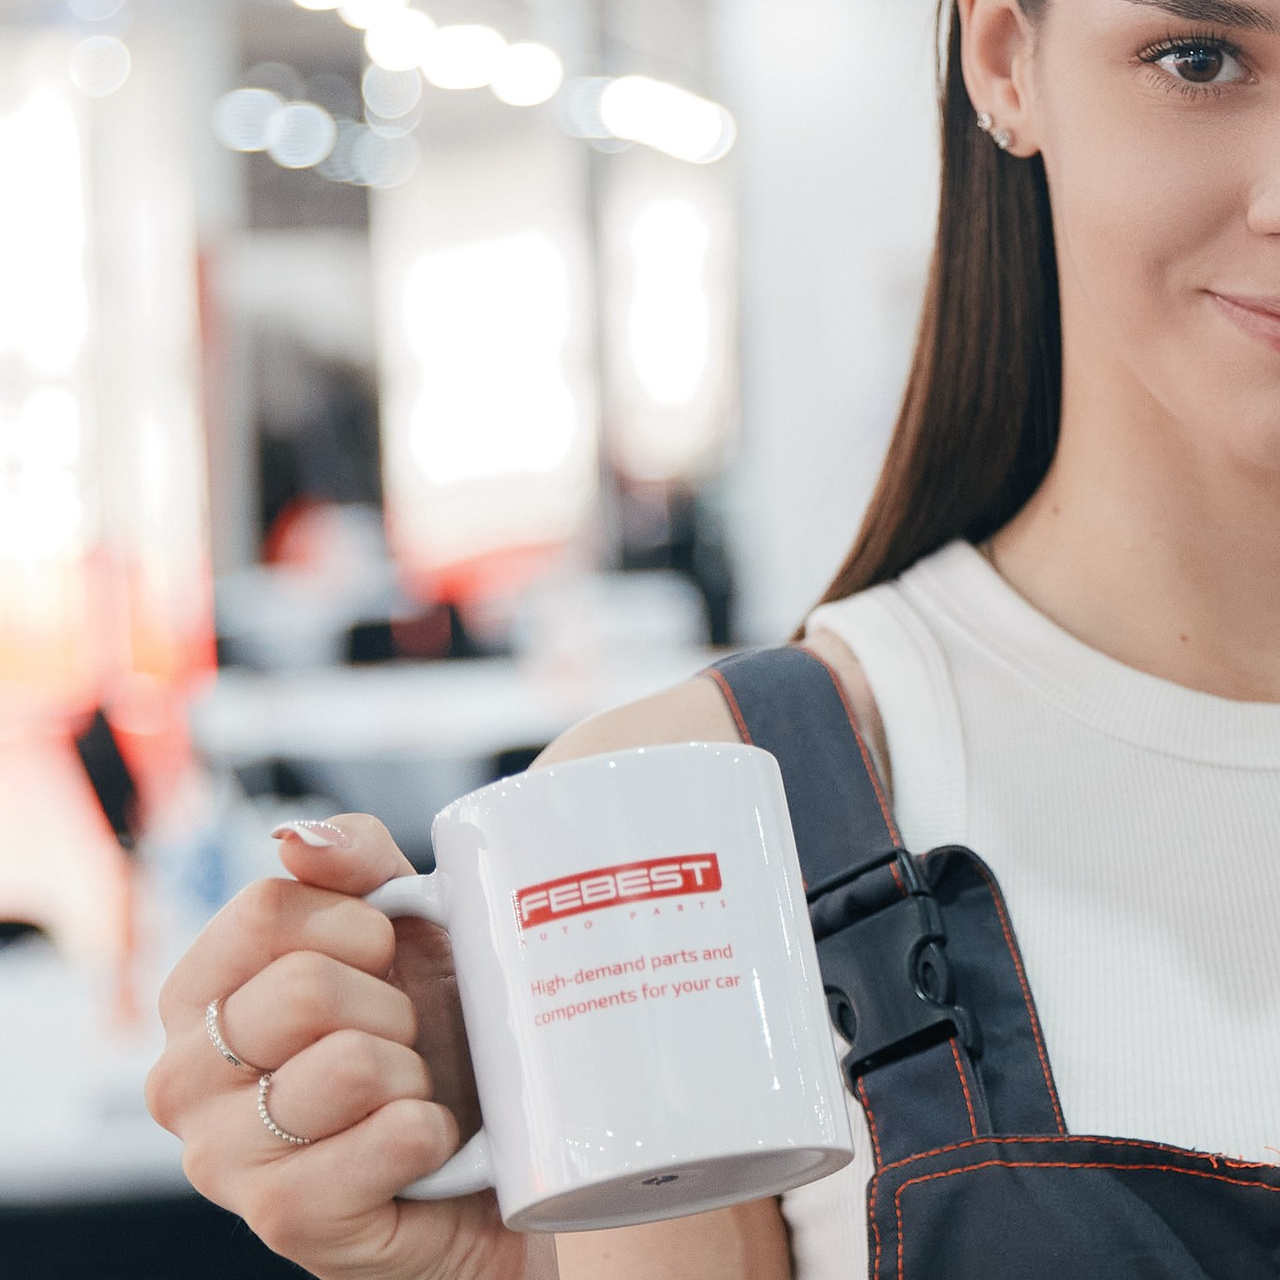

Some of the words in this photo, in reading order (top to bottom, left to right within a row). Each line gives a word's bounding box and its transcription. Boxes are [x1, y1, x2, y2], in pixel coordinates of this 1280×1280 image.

[520, 860, 712, 921] FEBEST
[629, 898, 727, 920] PARTS
[530, 955, 646, 997] High-demand
[650, 947, 698, 972] parts
[702, 943, 733, 961] and
[534, 988, 637, 1027] components
[641, 982, 668, 1000] for
[671, 977, 711, 998] your
[715, 974, 741, 989] car
